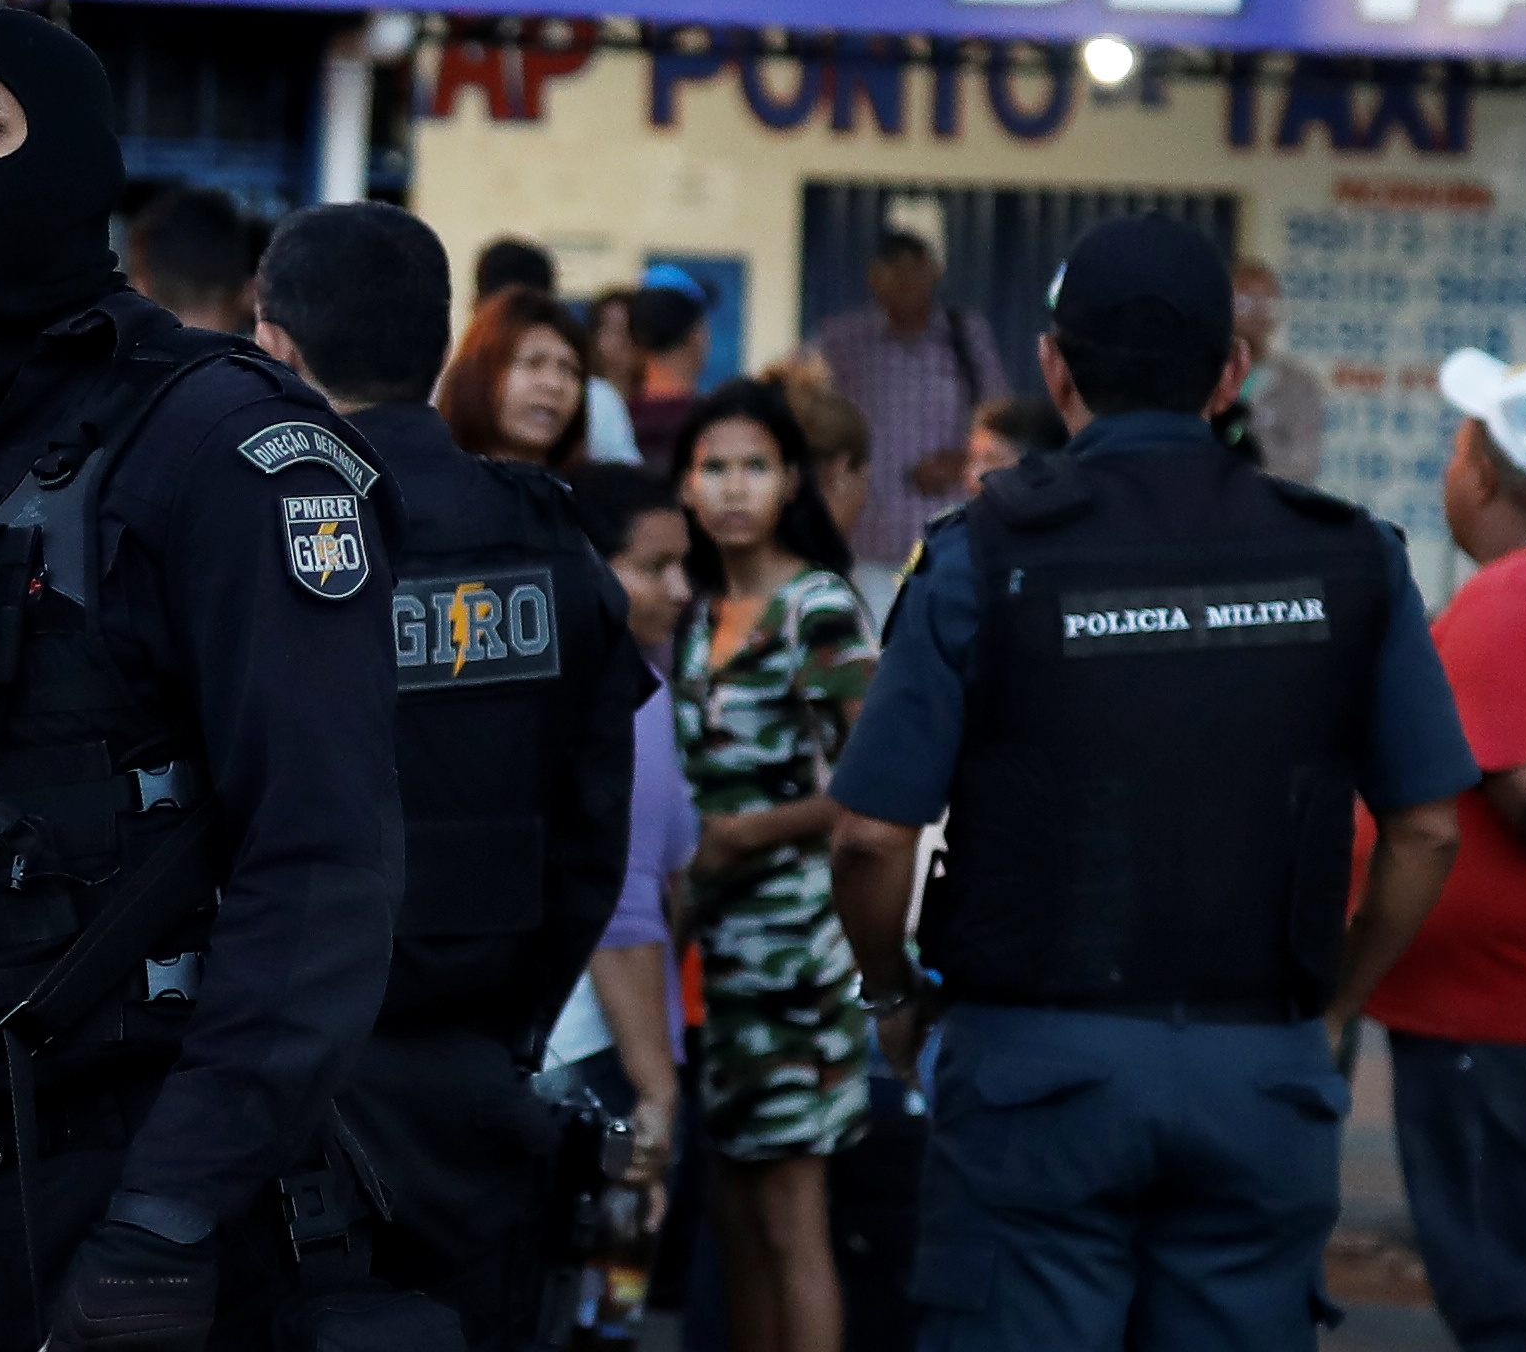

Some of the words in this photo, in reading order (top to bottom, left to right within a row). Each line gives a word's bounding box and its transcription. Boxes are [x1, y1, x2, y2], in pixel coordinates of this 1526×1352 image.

[253, 428, 311, 466] DIREÇÃO
[312, 431, 365, 487] DEFENSIVA
[288, 498, 354, 519] PMRR
[293, 533, 361, 573] GIRO
[392, 583, 550, 667] GIRO
[1063, 605, 1192, 639] POLICIA
[1204, 596, 1326, 630] MILITAR
